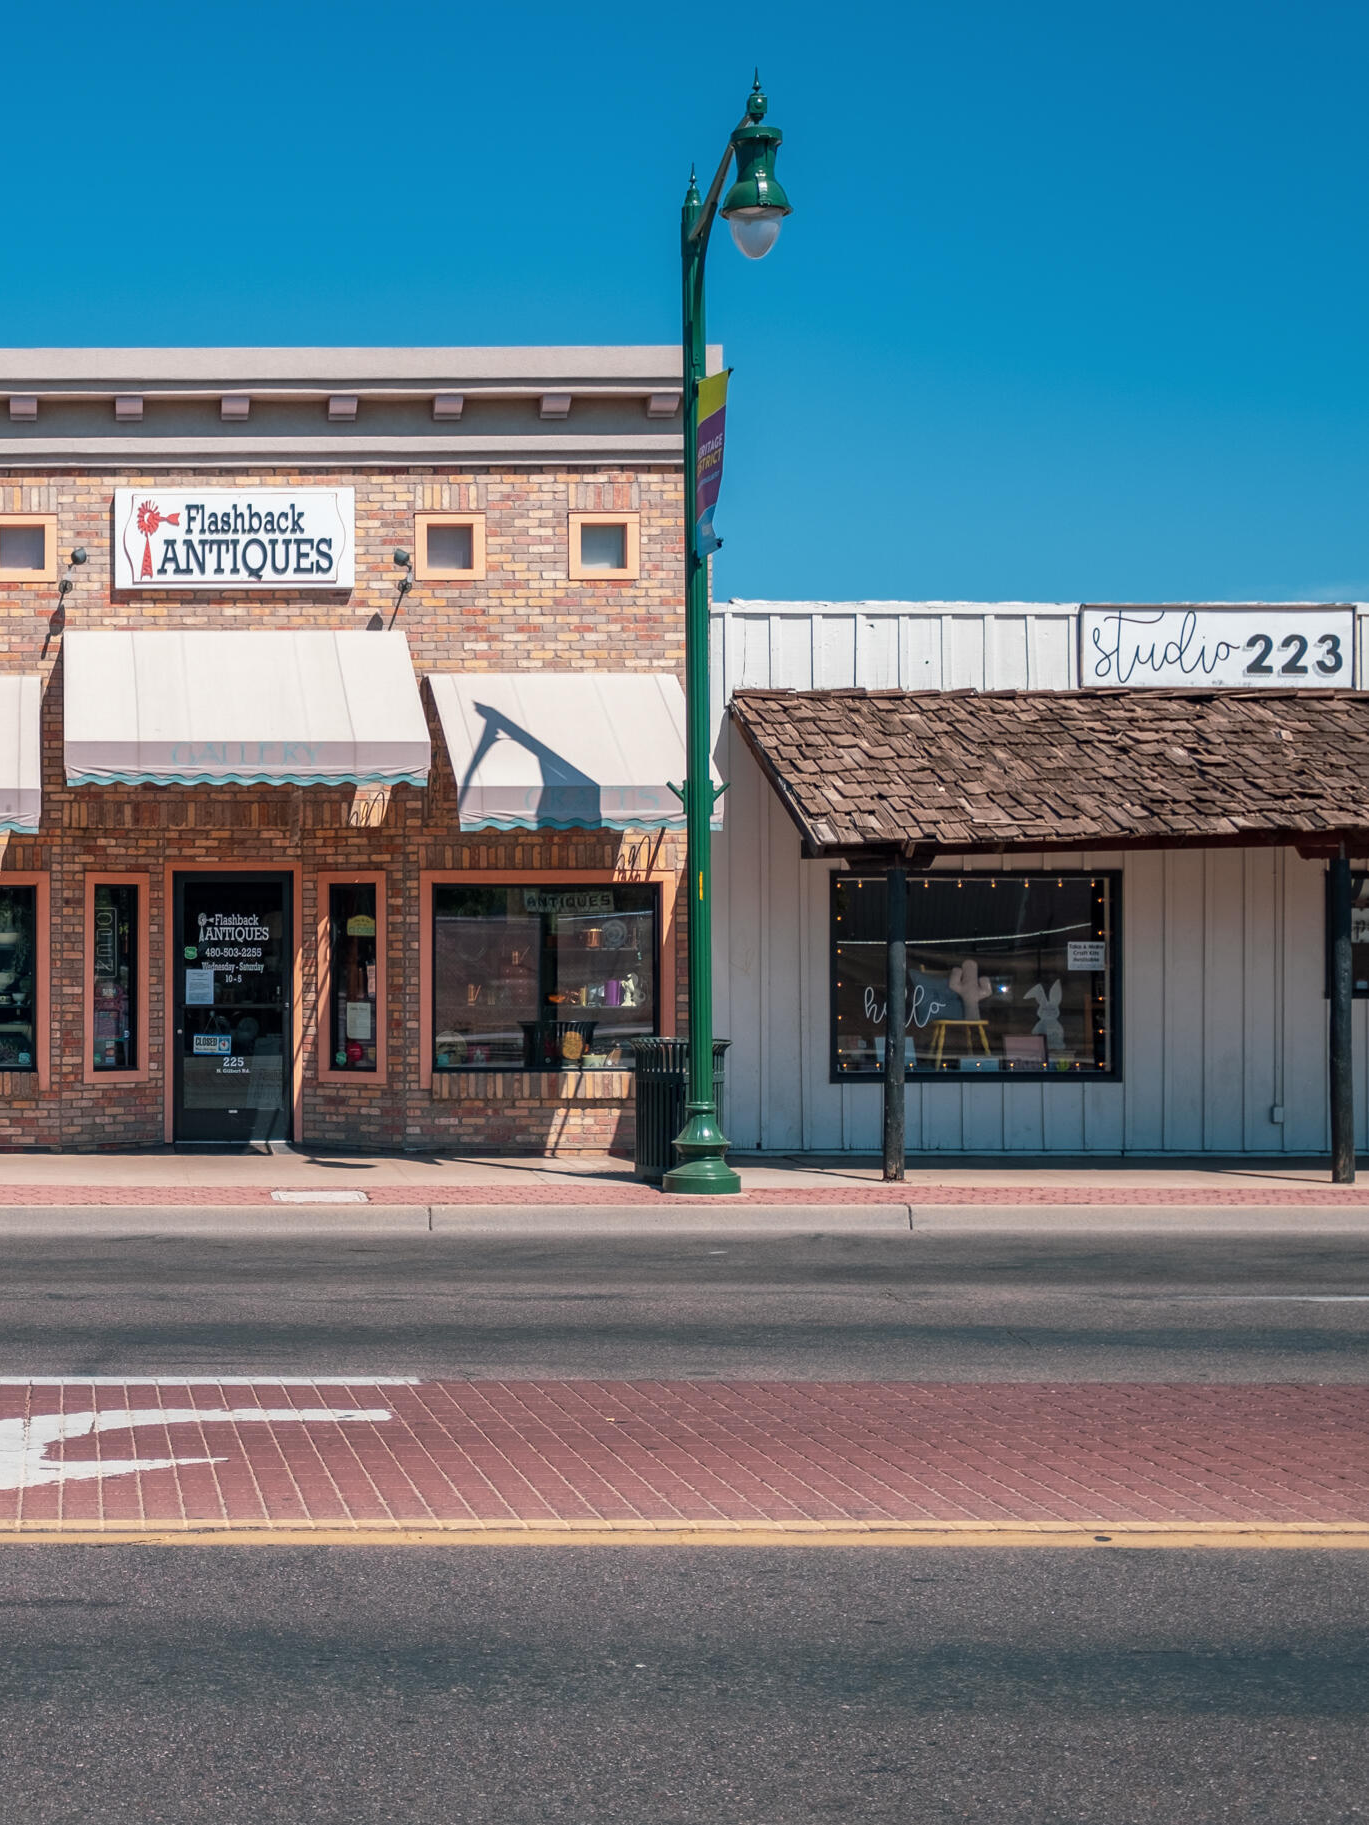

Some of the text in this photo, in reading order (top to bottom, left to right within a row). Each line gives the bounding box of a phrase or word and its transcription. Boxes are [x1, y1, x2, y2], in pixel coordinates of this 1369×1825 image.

[697, 433, 723, 461] ERITAGE
[185, 504, 305, 535] Flashback
[157, 538, 334, 580] ANTIQUES
[1243, 633, 1344, 678] 223
[171, 741, 324, 766] GALLERY
[524, 786, 661, 811] CRAFTS
[526, 894, 611, 908] ANTIQUES
[214, 913, 259, 926] Flashback
[96, 912, 114, 972] OPEN
[204, 927, 269, 942] ANTIQUES
[205, 947, 262, 957] 480-503-2255
[202, 962, 235, 973] Wednesday
[239, 962, 265, 973] Saturday
[225, 975, 233, 983] 10
[864, 985, 946, 1028] hlo
[196, 1037, 218, 1046] CLOSED
[223, 1057, 244, 1067] 225
